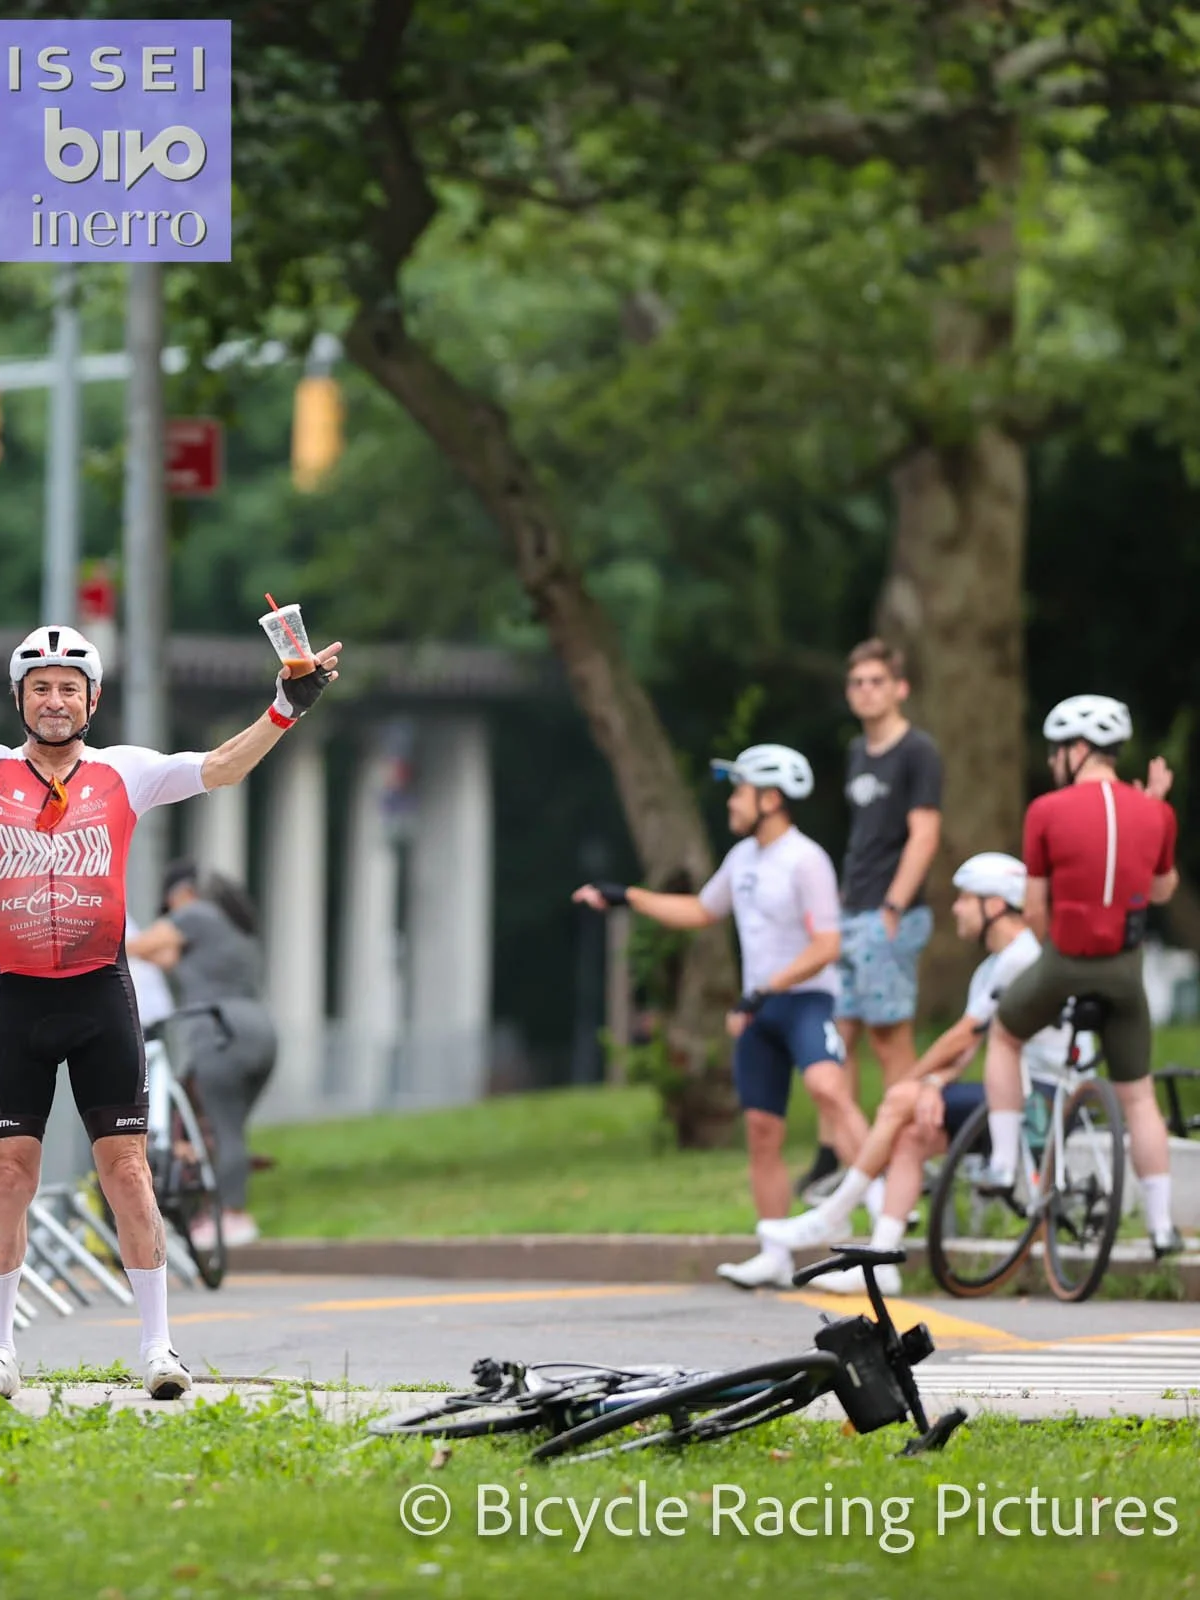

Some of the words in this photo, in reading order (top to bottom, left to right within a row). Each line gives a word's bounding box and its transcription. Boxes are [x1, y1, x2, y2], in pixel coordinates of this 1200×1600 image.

[1, 890, 103, 912] KEMPNER
[51, 915, 96, 927] COMPANY
[115, 1117, 146, 1127] BMC
